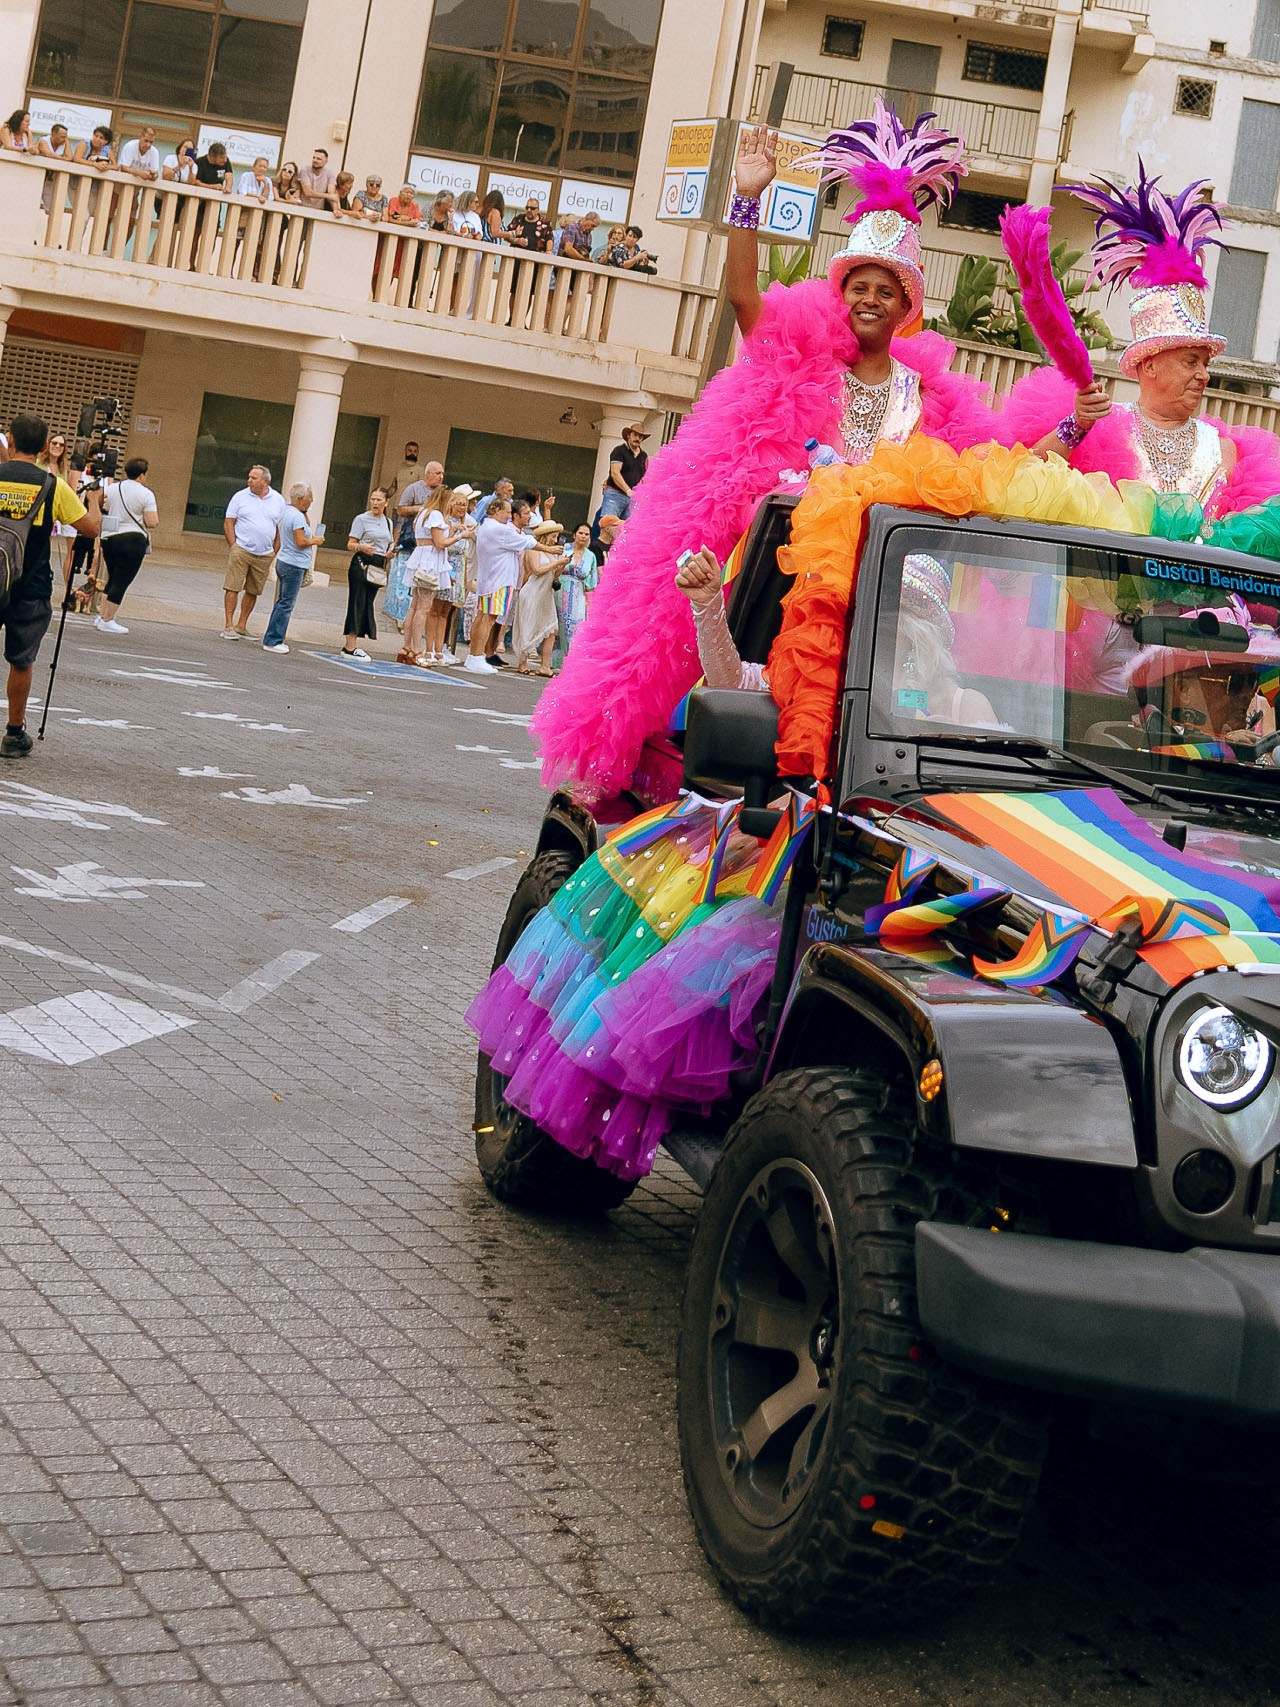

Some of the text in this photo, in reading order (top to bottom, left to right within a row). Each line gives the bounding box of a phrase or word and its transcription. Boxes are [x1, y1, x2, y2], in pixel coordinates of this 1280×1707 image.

[32, 111, 65, 122] FERRER
[672, 127, 714, 141] biblioteca
[670, 141, 712, 157] municipal
[420, 167, 472, 189] Clínica
[490, 180, 547, 202] médico
[566, 191, 615, 212] dental
[1145, 560, 1205, 585] Gusto!
